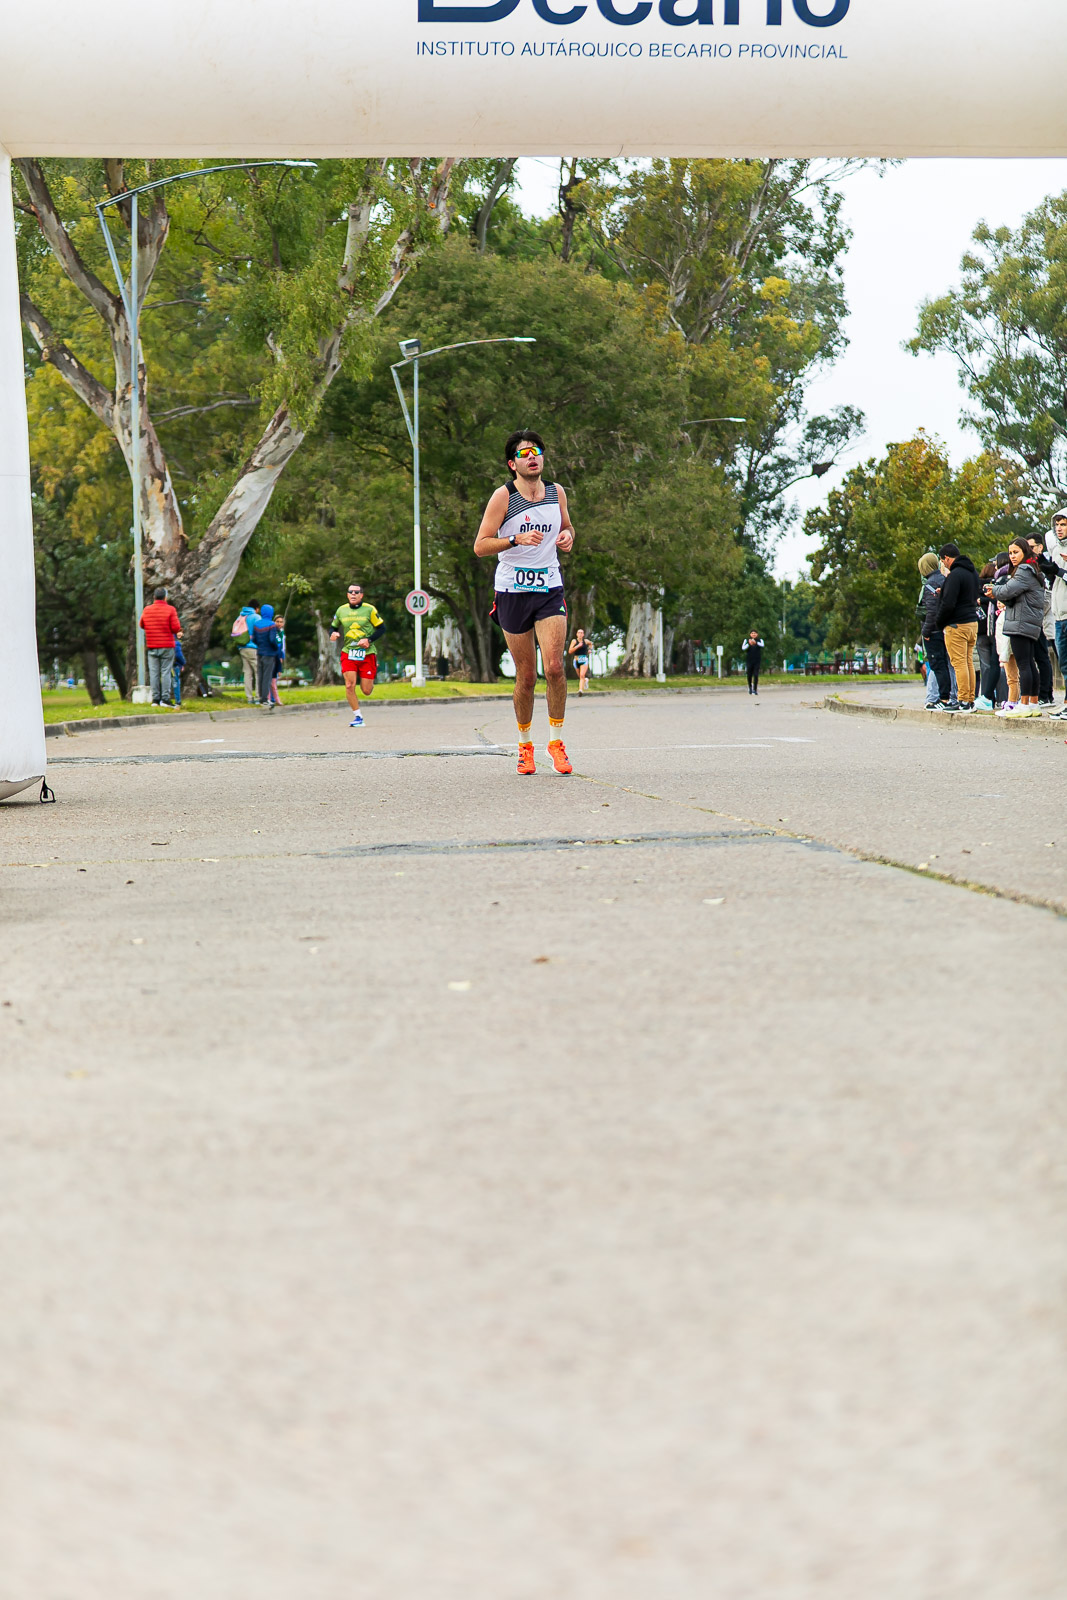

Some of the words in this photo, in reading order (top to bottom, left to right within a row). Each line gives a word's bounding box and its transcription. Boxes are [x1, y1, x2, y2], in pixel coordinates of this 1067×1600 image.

[417, 41, 515, 56] INSTITUTO
[521, 38, 642, 58] AUTÁRQUICO
[649, 42, 732, 58] BECARIO
[739, 43, 848, 59] PROVINCIAL
[516, 569, 545, 587] 095
[412, 595, 425, 608] 20
